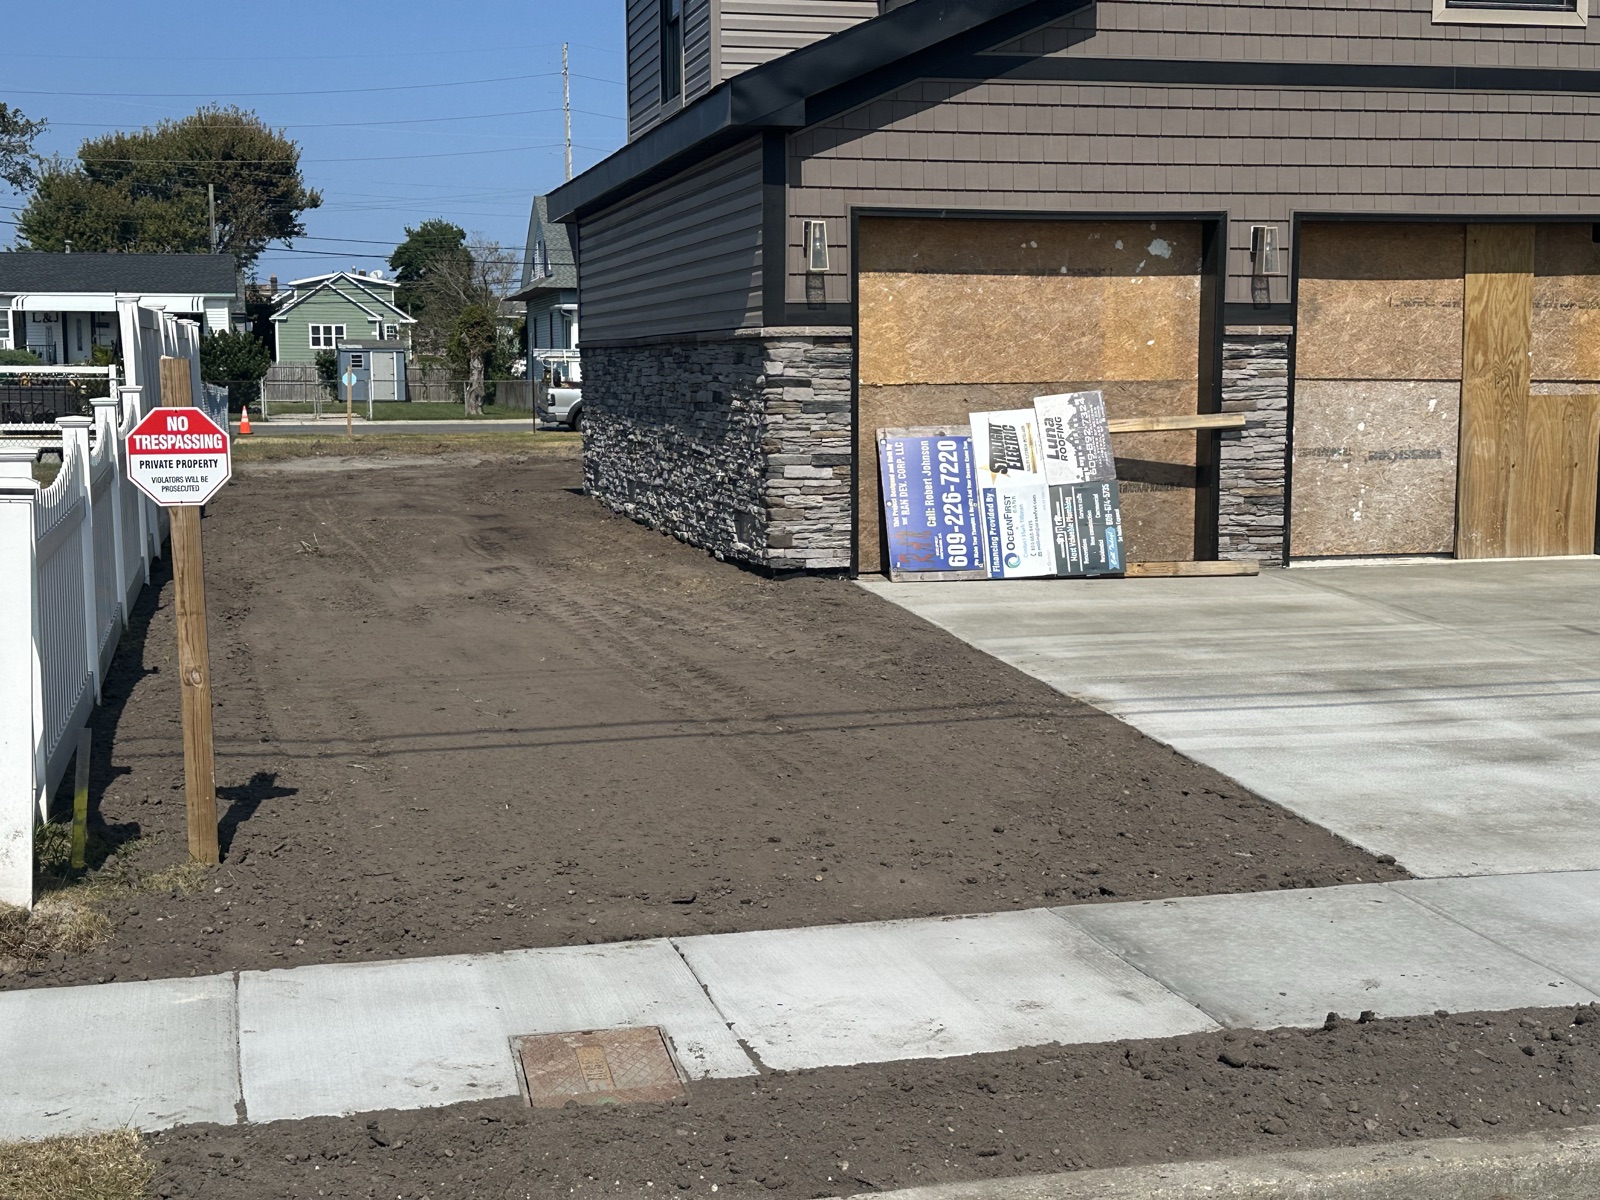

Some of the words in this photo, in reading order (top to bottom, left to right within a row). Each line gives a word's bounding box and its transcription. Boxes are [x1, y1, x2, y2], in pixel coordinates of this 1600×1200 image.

[32, 312, 58, 323] L&J
[167, 416, 188, 431] NO
[133, 434, 222, 450] TRESPASSING
[895, 442, 904, 455] LLC
[988, 422, 1008, 474] STARLIGHT
[1002, 424, 1024, 471] ELECTRIC
[1044, 418, 1060, 460] Luna
[1054, 416, 1068, 461] ROOFING
[140, 460, 173, 469] PRIVATE
[176, 459, 218, 468] PROPERTY
[897, 457, 906, 478] CORP.
[921, 440, 931, 476] Johnson
[898, 481, 908, 497] DEV.
[924, 478, 933, 505] Robert
[986, 493, 994, 502] By
[937, 440, 968, 566] 609-226-7220
[1065, 496, 1073, 522] Plumbing
[926, 508, 936, 526] Call:
[988, 503, 997, 534] Provided
[1068, 523, 1076, 546] Valuable
[990, 537, 1000, 572] Financing
